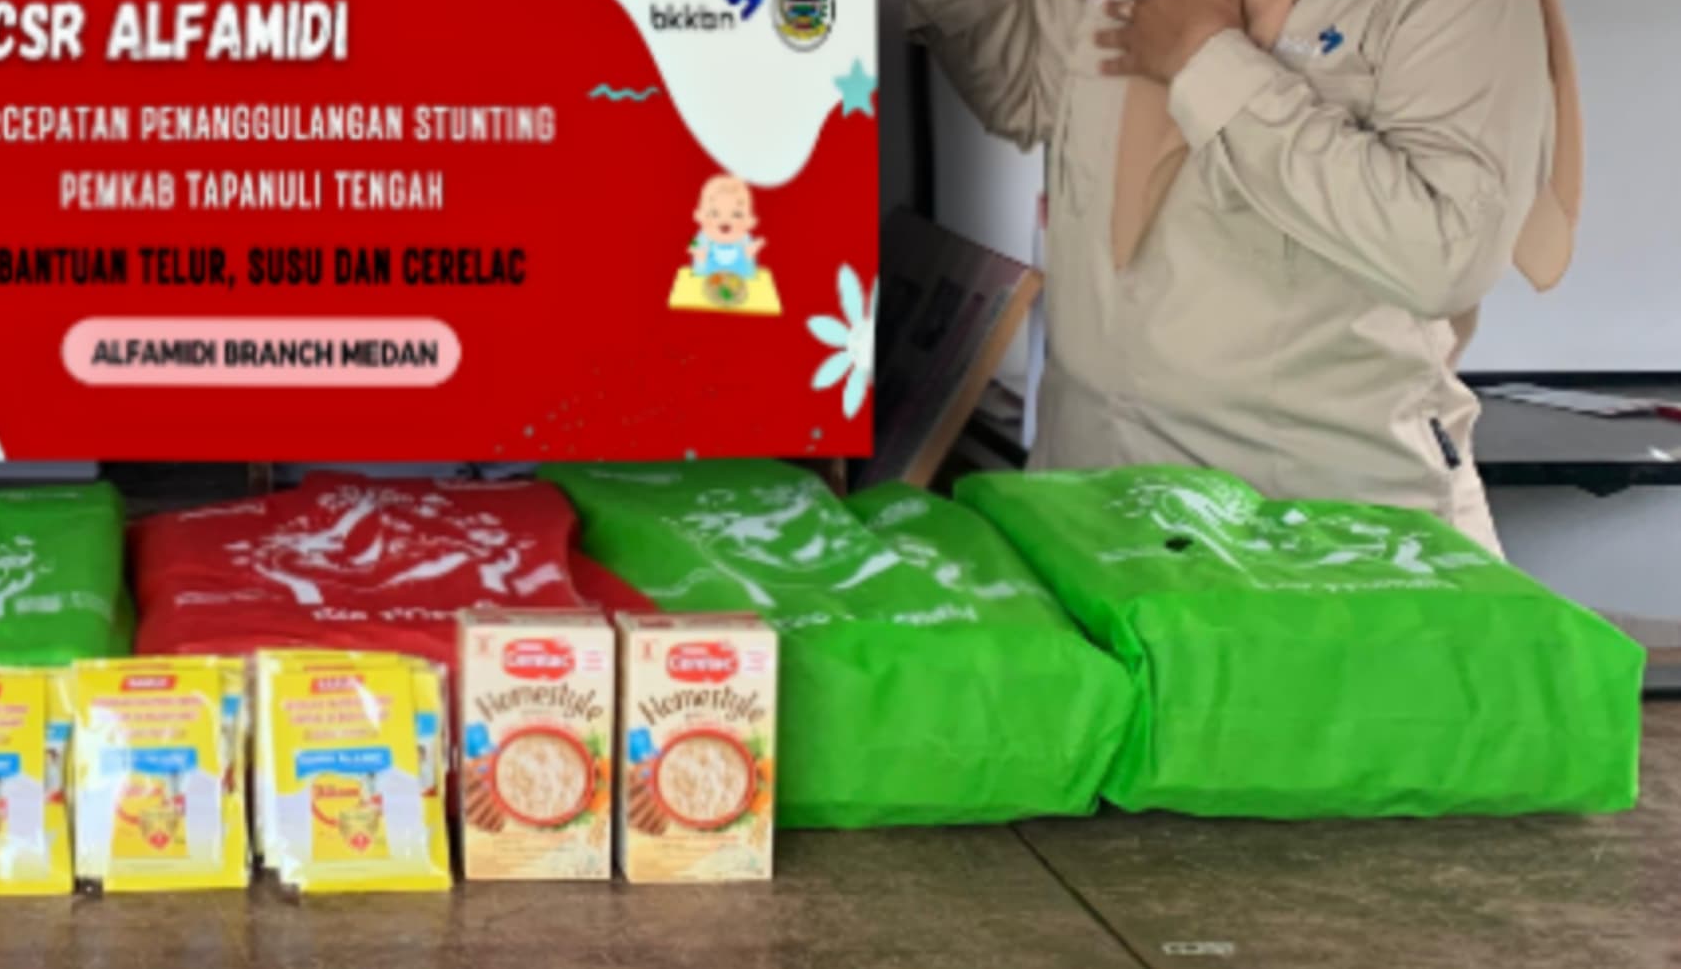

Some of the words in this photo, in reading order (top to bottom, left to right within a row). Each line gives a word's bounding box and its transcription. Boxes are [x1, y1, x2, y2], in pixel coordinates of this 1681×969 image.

[105, 0, 348, 60] ALFAMIDI
[649, 4, 735, 30] bkkbn
[141, 104, 404, 143] PENANGGULANGAN
[414, 104, 556, 143] STUNTING
[59, 171, 175, 209] PEMKAB
[185, 171, 322, 209] TAPANULI
[334, 171, 444, 209] TENGAH
[137, 247, 236, 290] TELUR,
[247, 247, 323, 285] SUSU
[334, 247, 391, 285] DAN
[402, 247, 526, 285] CERELAC
[91, 340, 216, 366] ALFAMIDI
[223, 340, 333, 366] BRANCH
[340, 340, 438, 366] MEDAN
[475, 683, 604, 723] Homestyle
[638, 685, 765, 726] Homestyle
